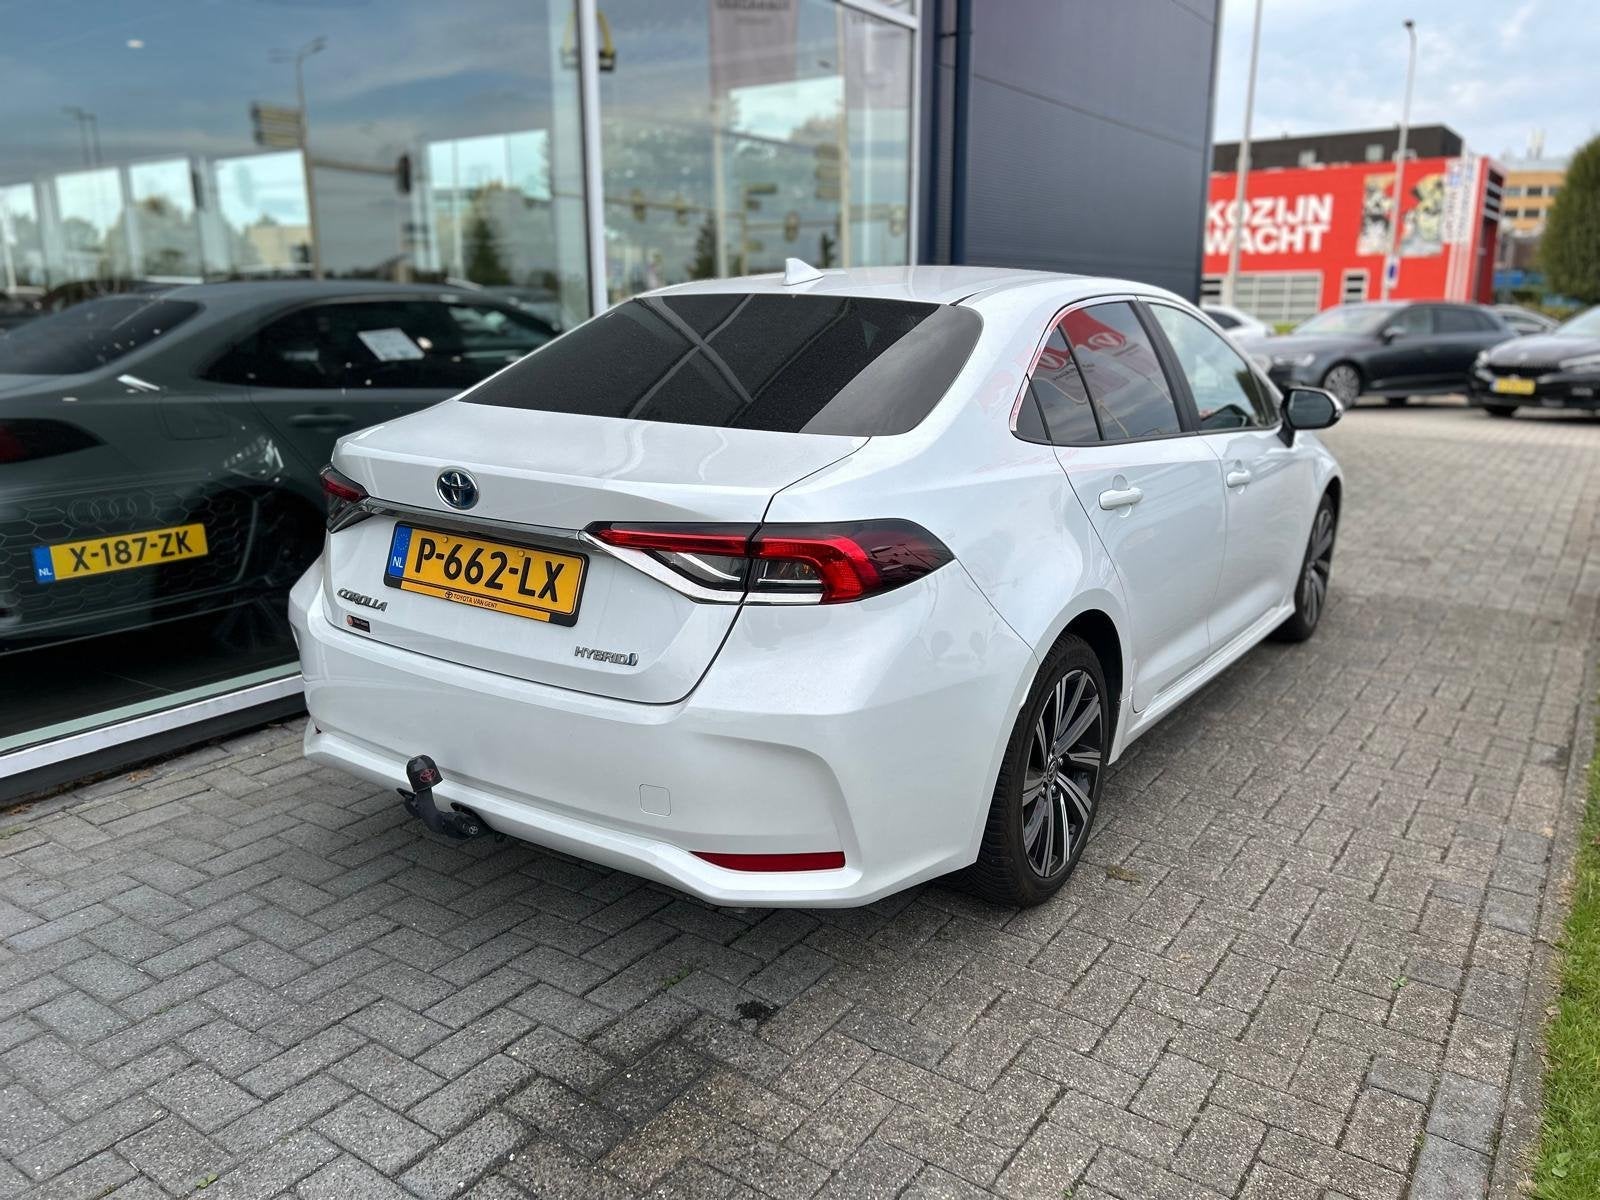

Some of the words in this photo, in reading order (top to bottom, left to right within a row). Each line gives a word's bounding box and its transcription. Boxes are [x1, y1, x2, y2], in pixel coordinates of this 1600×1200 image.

[1205, 194, 1334, 226] KOZIJN
[1204, 224, 1331, 255] WACHT
[70, 530, 192, 572] X-187-ZK
[391, 556, 403, 569] NL
[38, 567, 52, 577] NL
[414, 538, 564, 602] P-662-LX
[337, 588, 388, 612] COROLLA
[453, 593, 473, 604] TOYOTA
[473, 597, 485, 606] VAN
[574, 646, 628, 666] HYBRID
